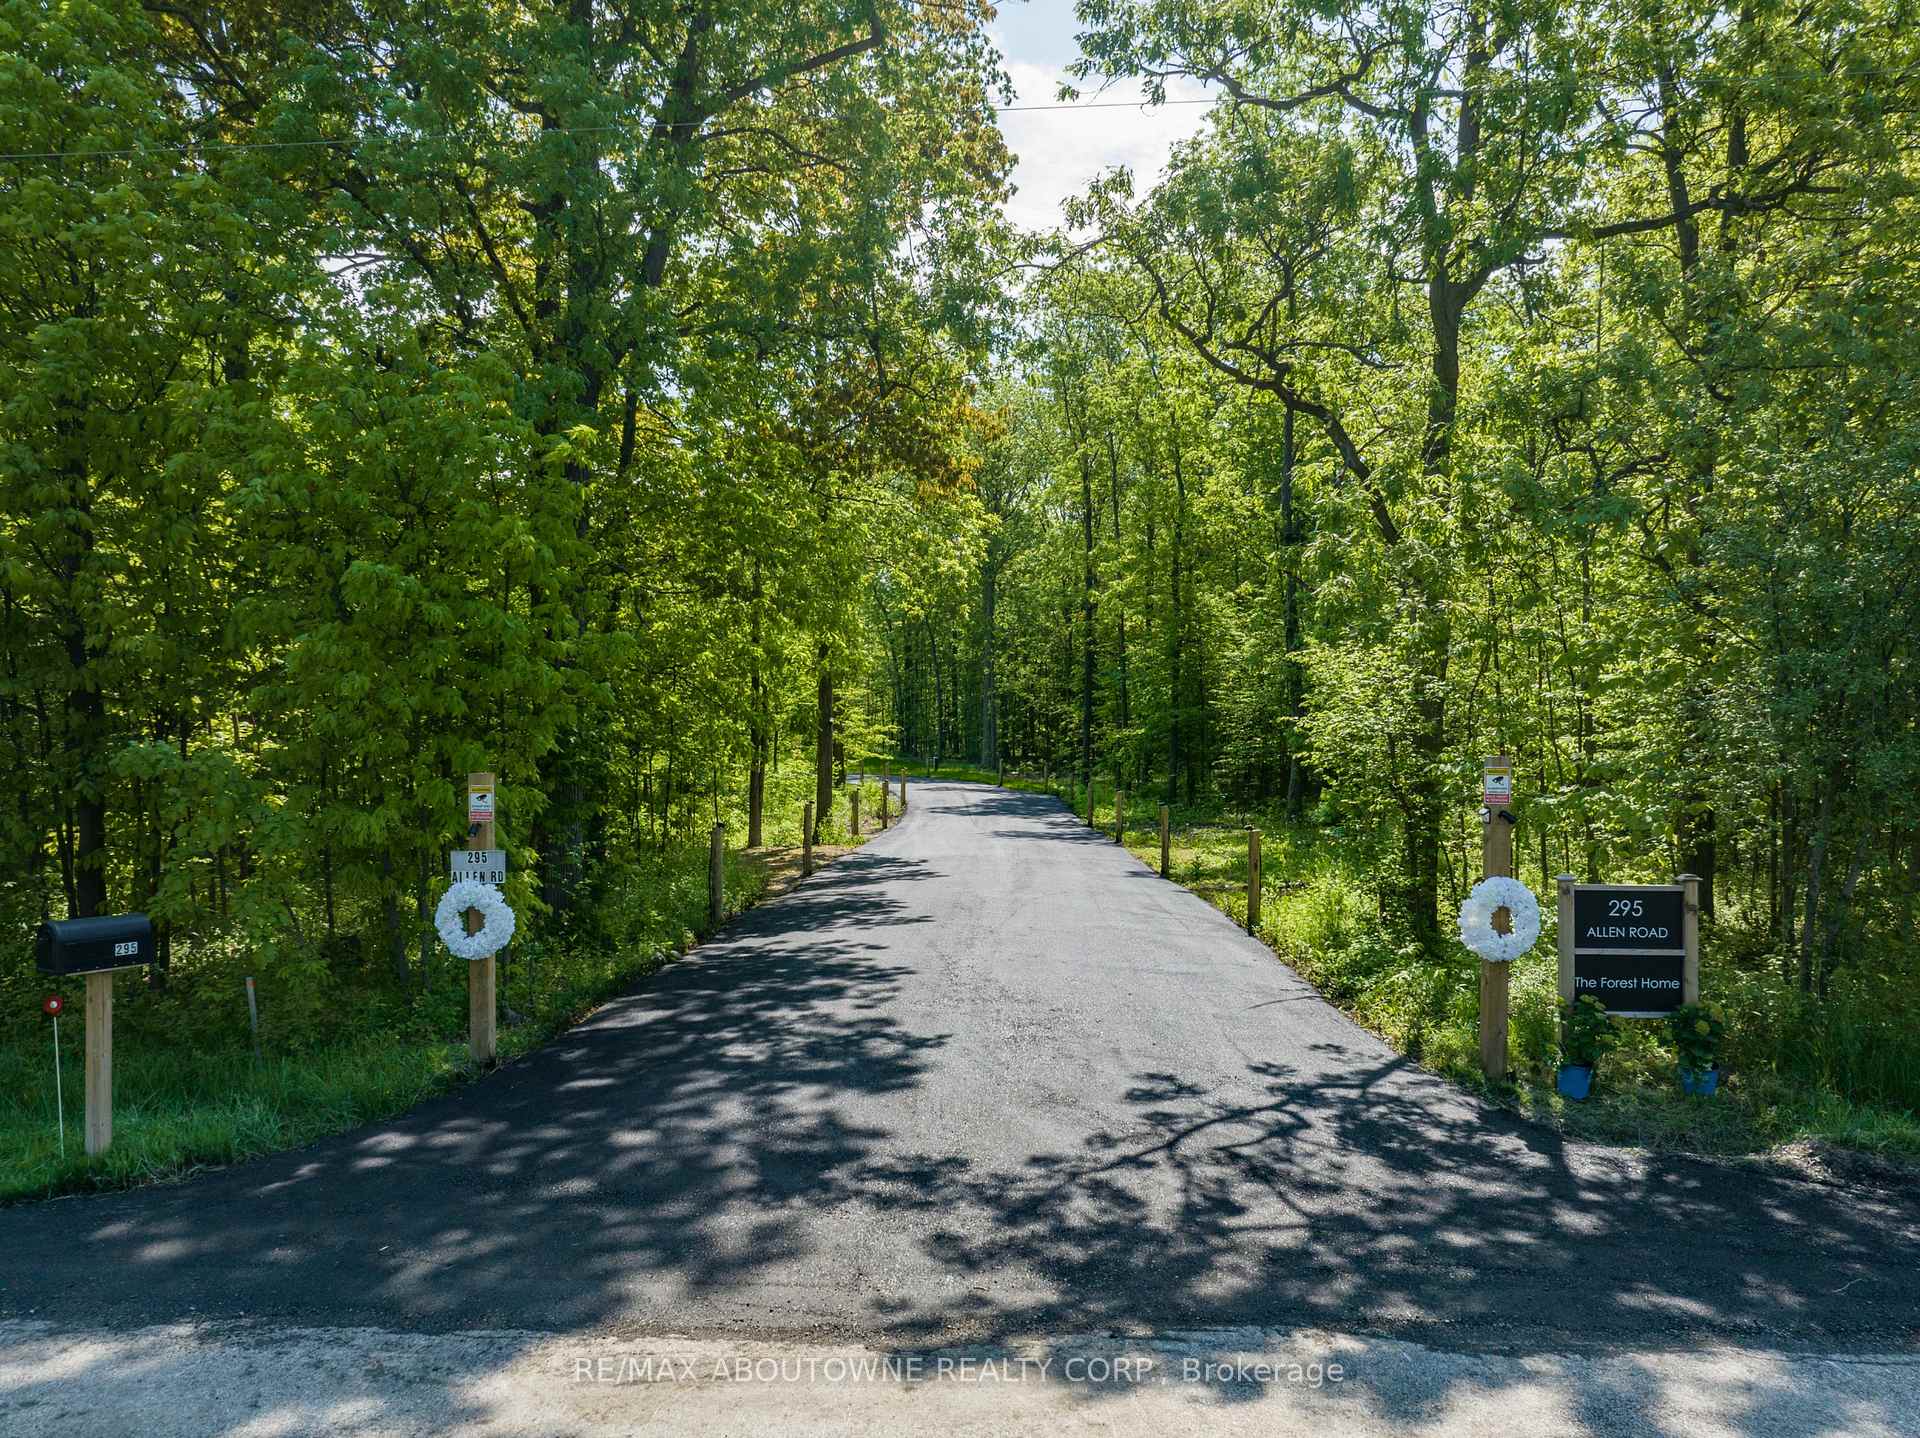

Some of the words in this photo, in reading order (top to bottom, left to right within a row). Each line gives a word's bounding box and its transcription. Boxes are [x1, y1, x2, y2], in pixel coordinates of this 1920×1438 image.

[467, 851, 488, 863] 295
[490, 871, 504, 882] RD
[1608, 899, 1643, 917] 295
[1586, 927, 1625, 938] ALLEN
[1629, 927, 1669, 938] ROAD
[116, 943, 137, 954] 295
[1575, 977, 1597, 988] The
[1600, 977, 1637, 989] Forest
[1641, 978, 1680, 989] Home
